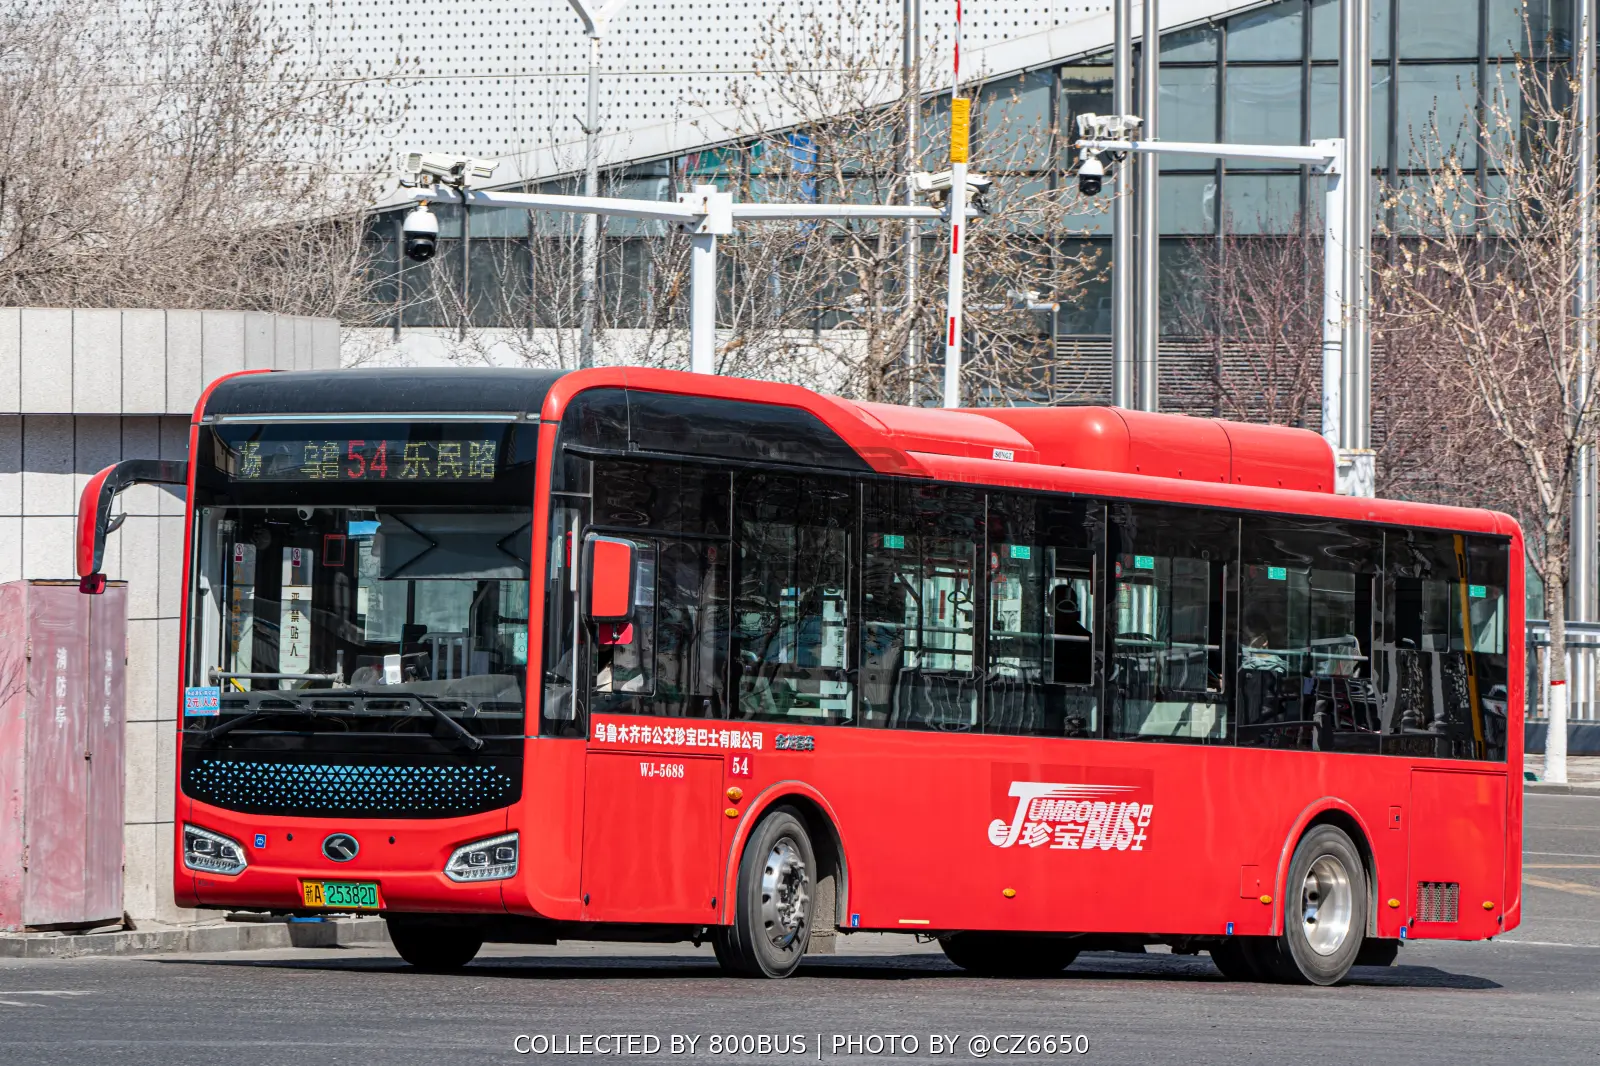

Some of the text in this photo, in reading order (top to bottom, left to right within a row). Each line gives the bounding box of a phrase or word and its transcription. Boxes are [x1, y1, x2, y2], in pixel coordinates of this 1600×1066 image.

[348, 440, 388, 478] 54
[401, 440, 496, 478] 乐民路
[594, 723, 763, 749] 乌鲁木齐市公交珍宝巴士有限公司
[640, 763, 684, 778] WJ-5688
[732, 757, 749, 775] 54
